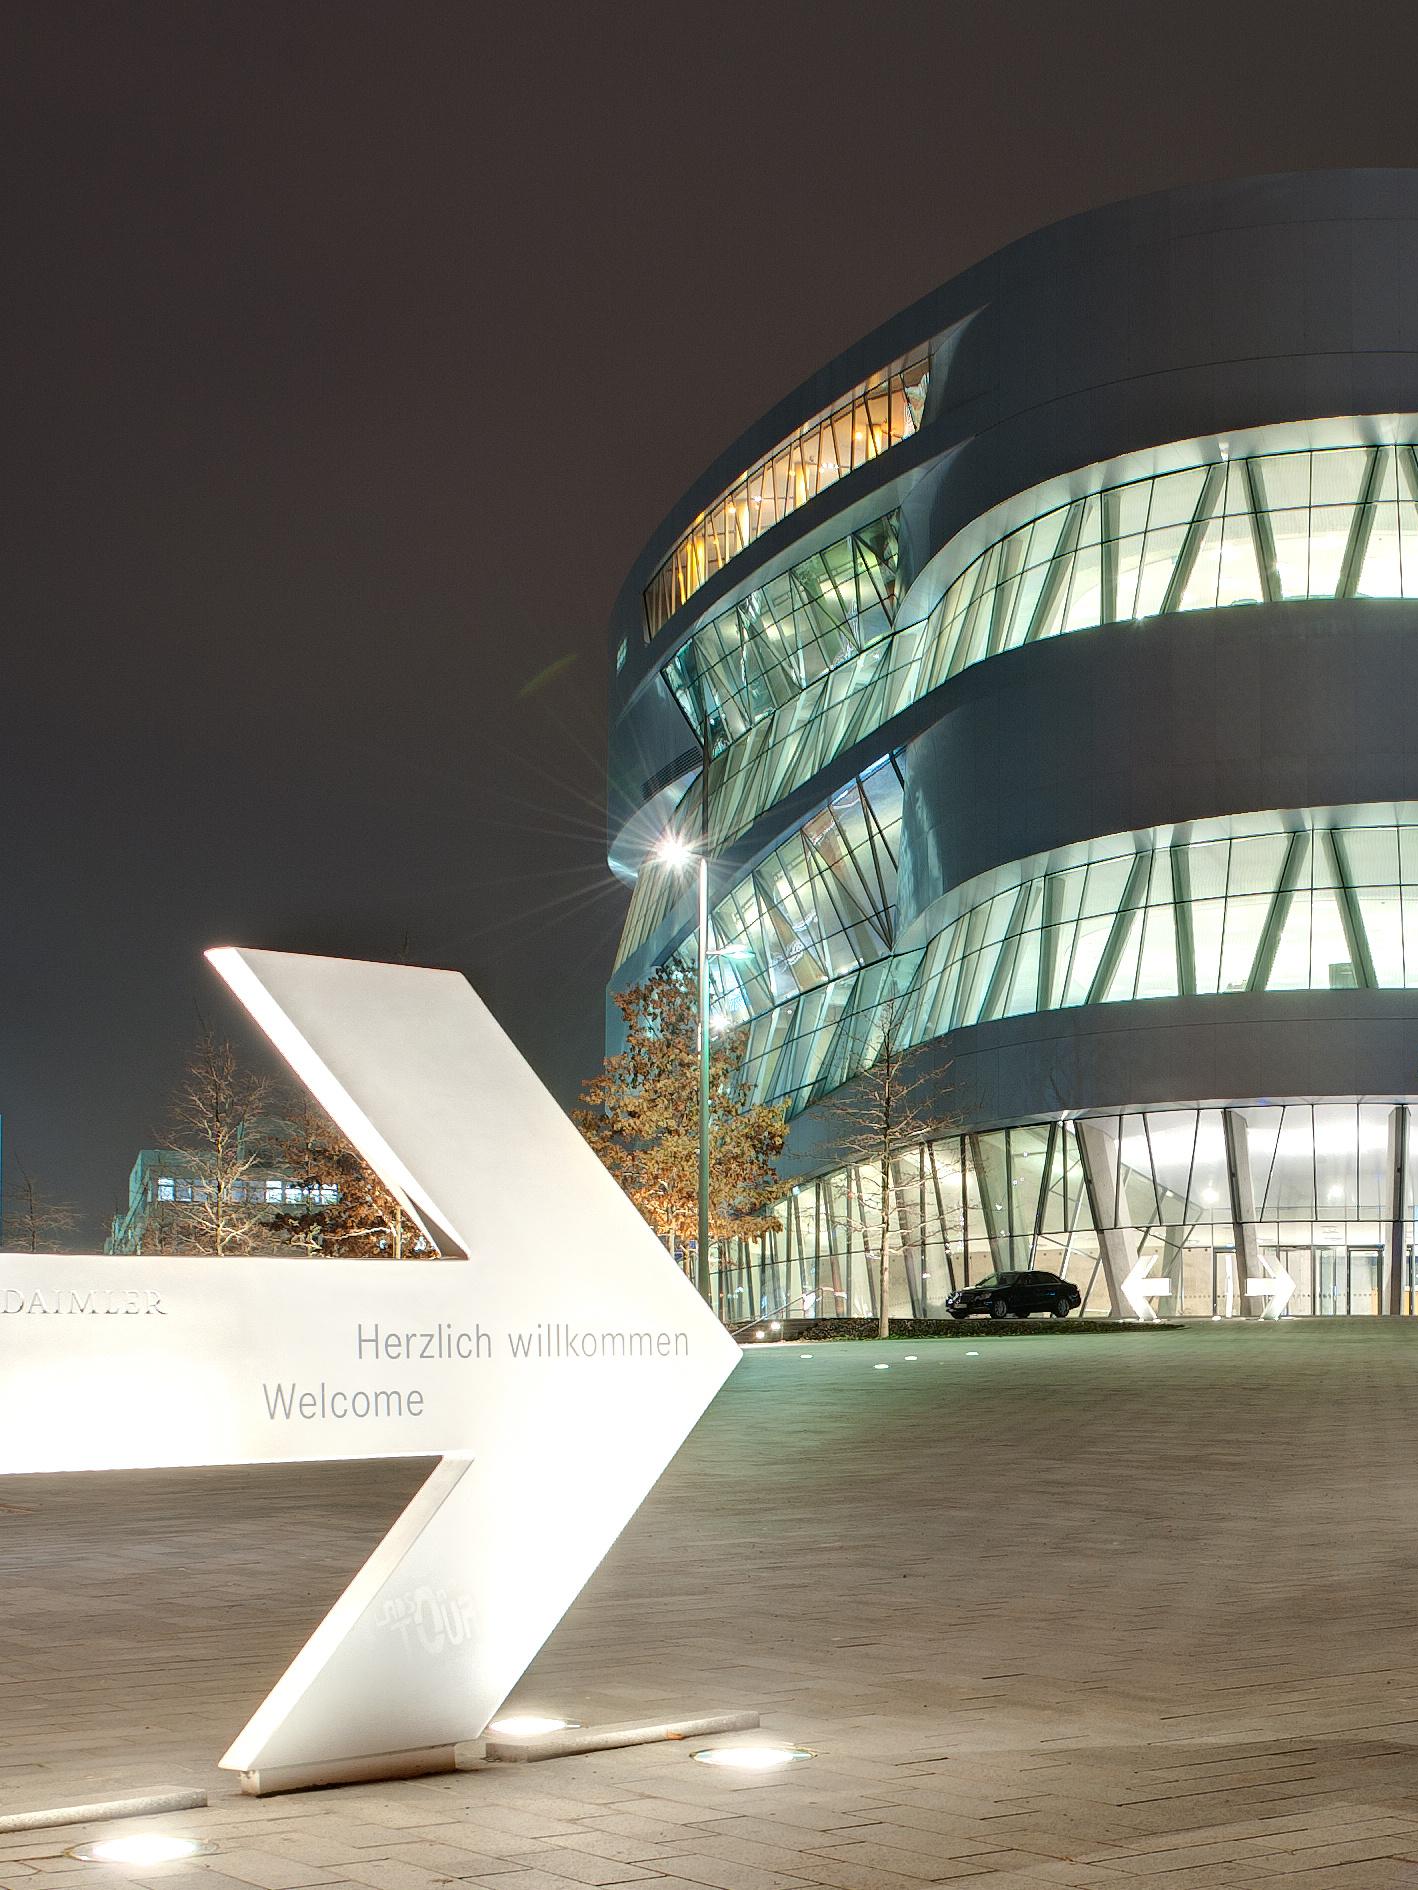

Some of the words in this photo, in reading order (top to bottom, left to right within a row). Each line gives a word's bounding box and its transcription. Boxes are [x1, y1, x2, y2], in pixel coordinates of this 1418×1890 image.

[1, 1288, 168, 1316] DAIMLER
[357, 1323, 492, 1360] Herzlich
[508, 1323, 689, 1358] willkommen
[262, 1382, 425, 1420] Welcome
